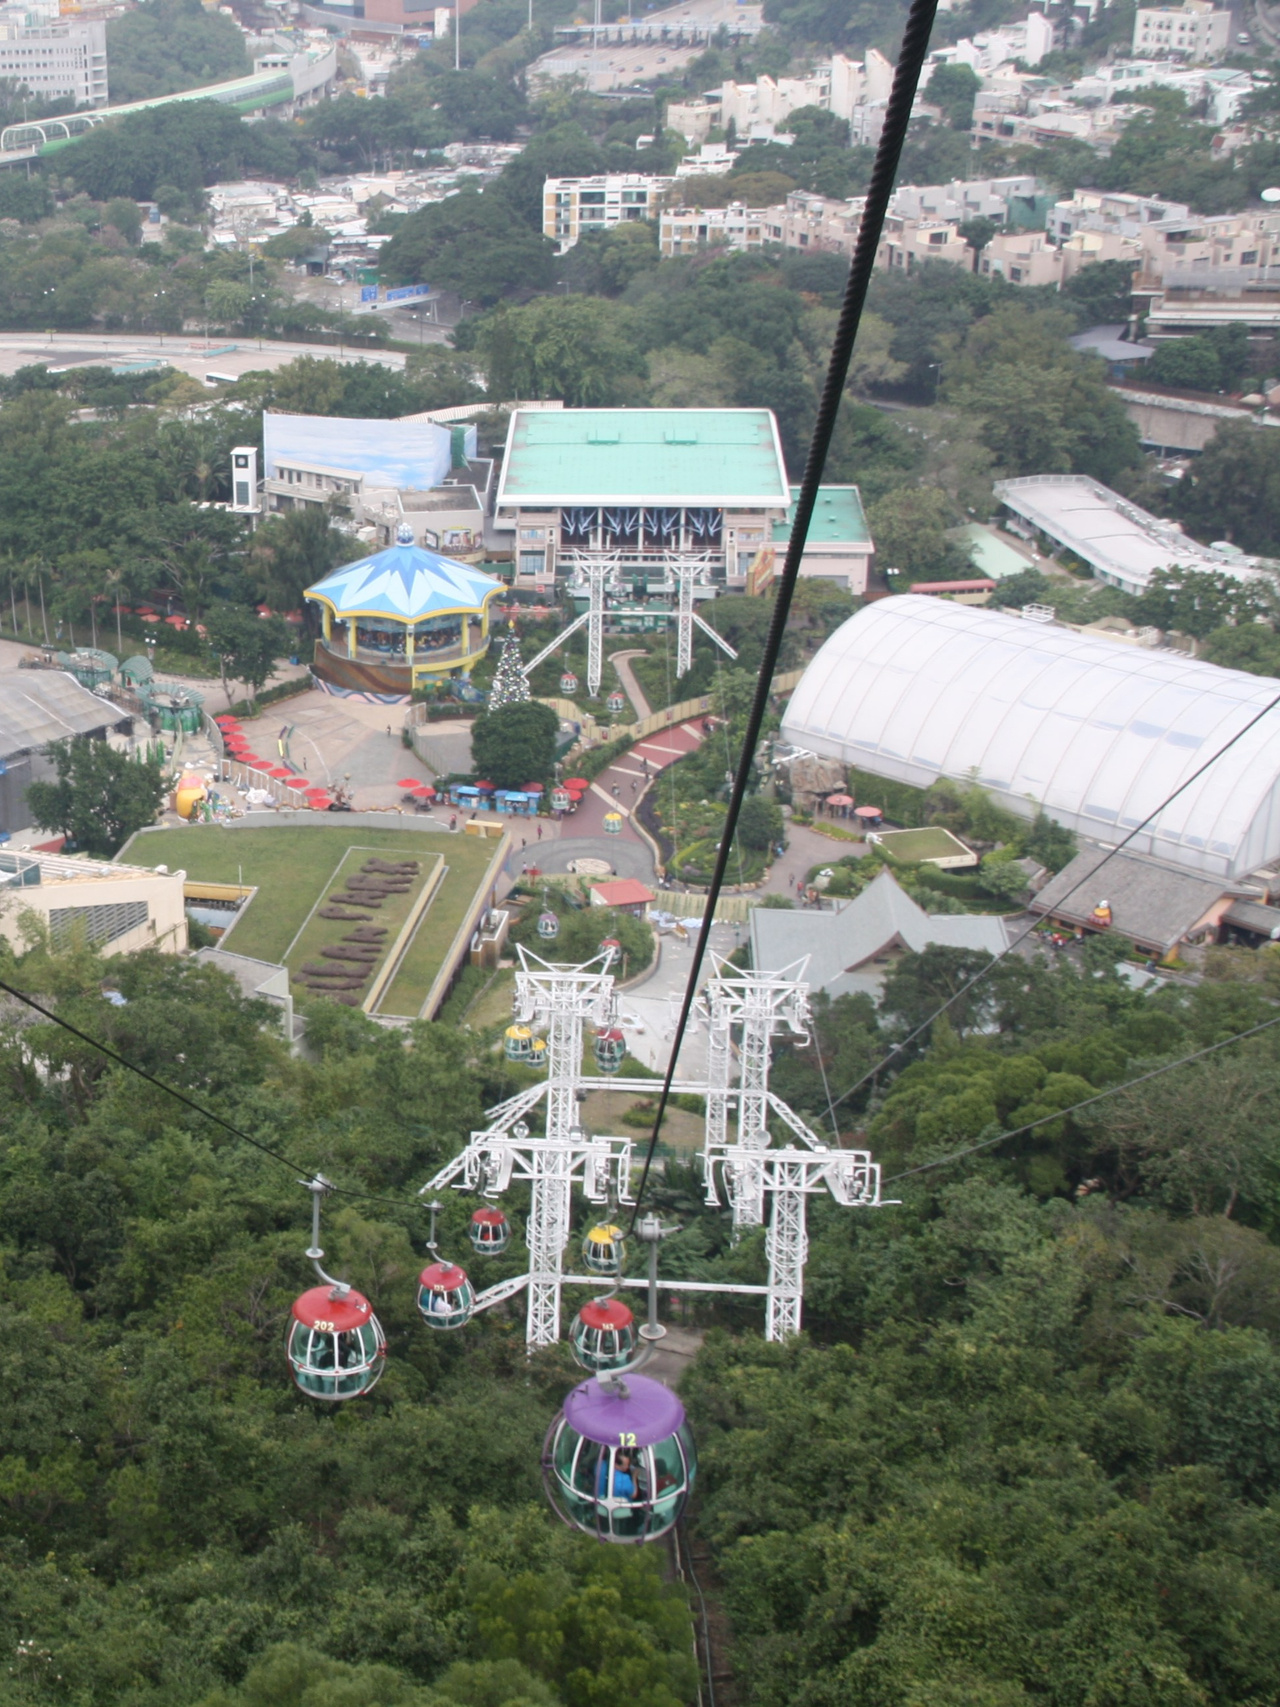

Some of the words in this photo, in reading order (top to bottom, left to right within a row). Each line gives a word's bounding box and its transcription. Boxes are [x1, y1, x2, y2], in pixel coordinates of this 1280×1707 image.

[318, 857, 420, 921] PARK
[313, 1320, 335, 1331] 202
[618, 1432, 637, 1447] 12
